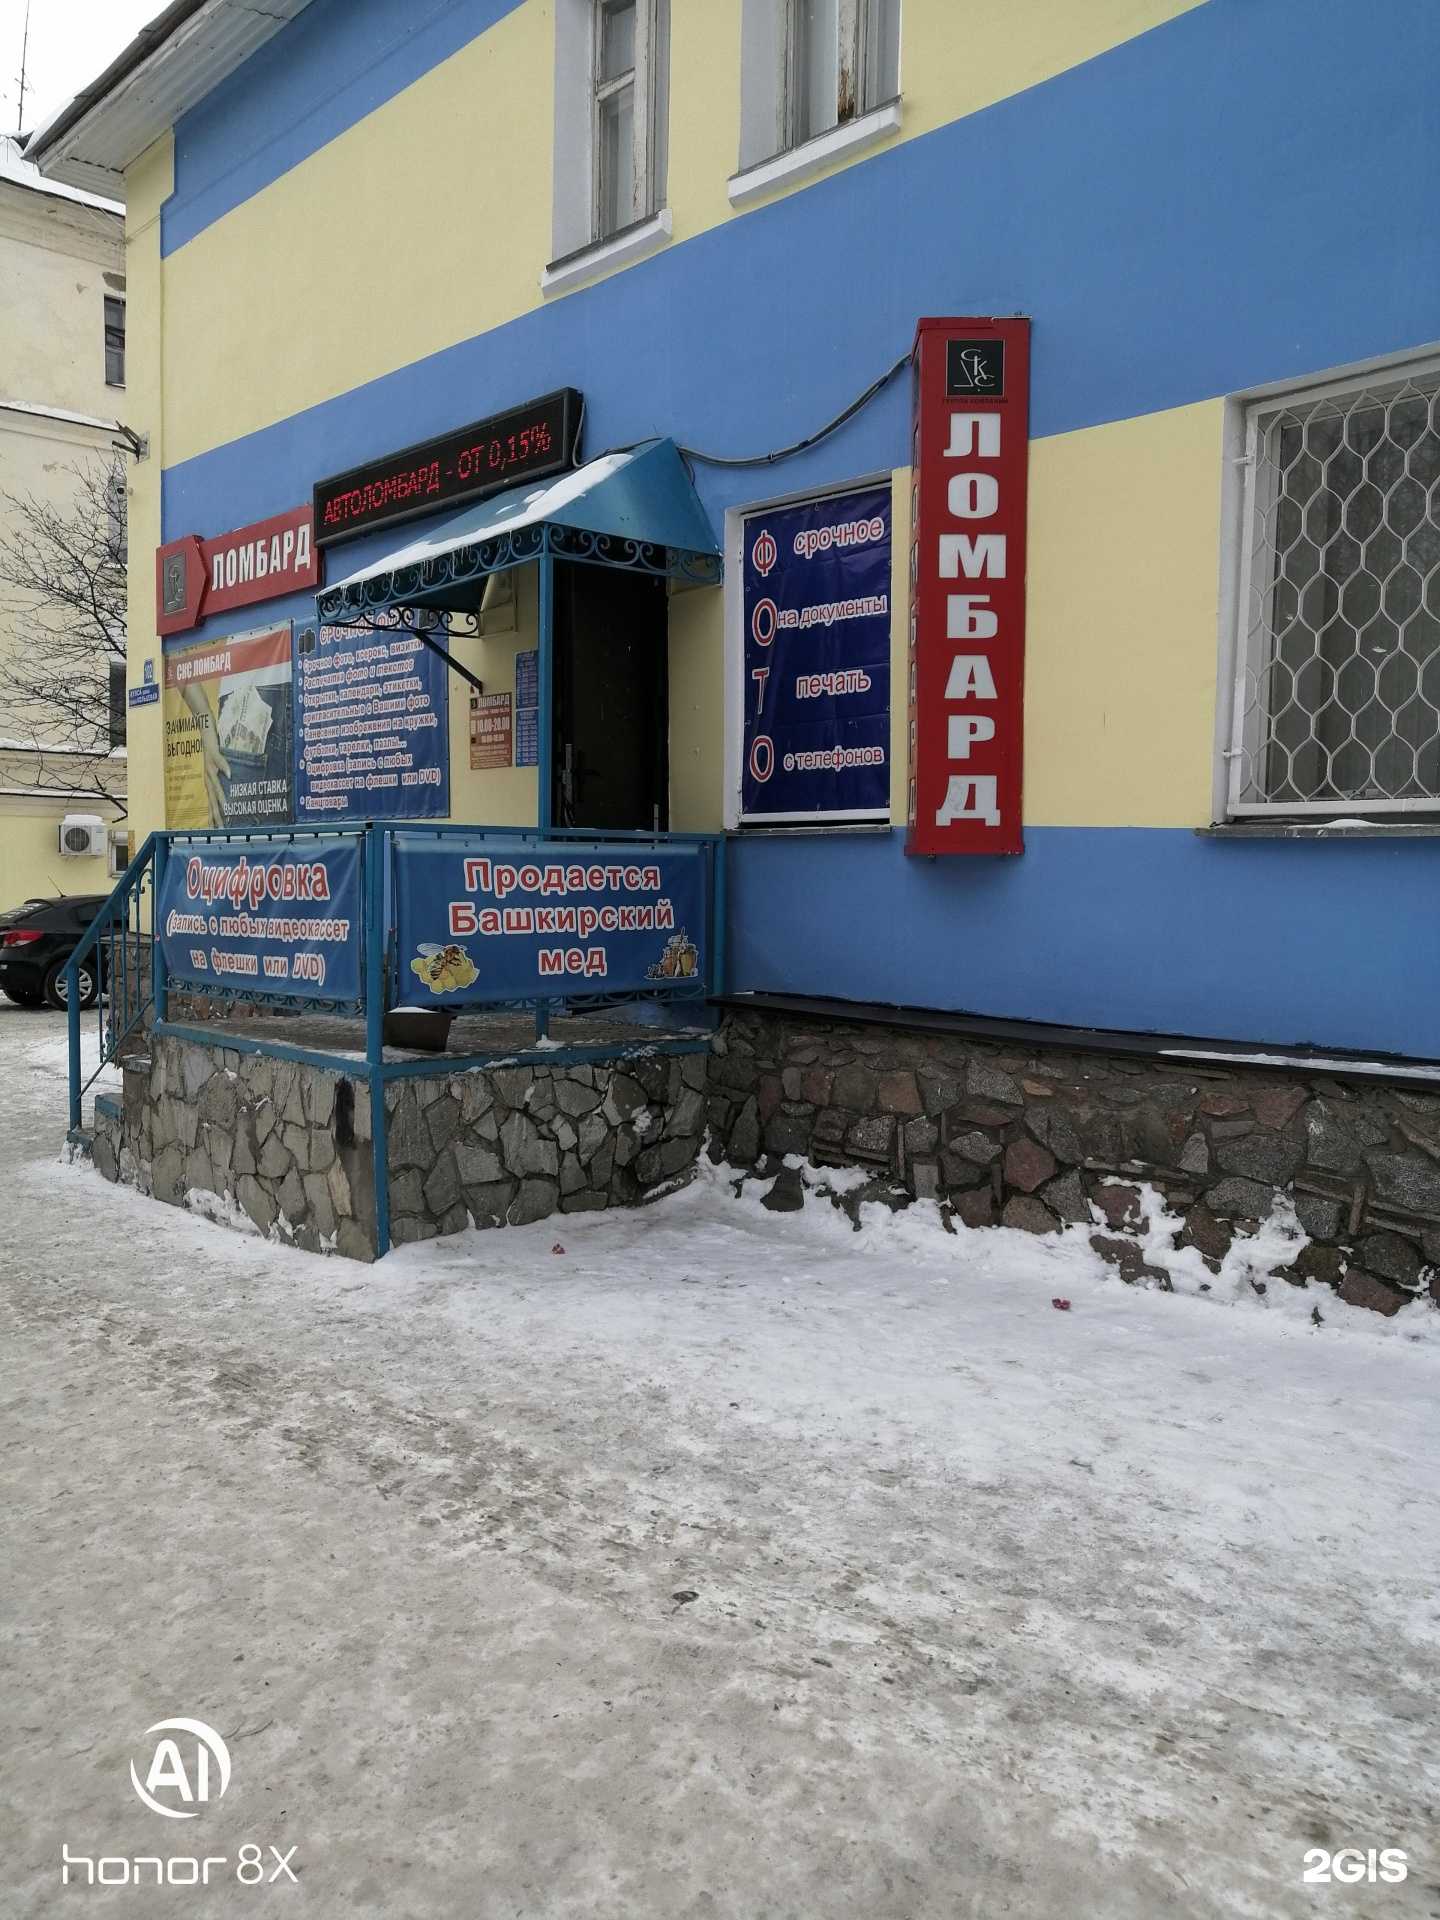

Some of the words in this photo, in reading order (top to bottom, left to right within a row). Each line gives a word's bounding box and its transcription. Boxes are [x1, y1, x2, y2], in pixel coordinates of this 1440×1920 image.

[323, 460, 440, 525] АВТОЛОМБАРД
[458, 444, 485, 481] ОТ
[488, 422, 552, 471] 0,15%
[794, 517, 884, 559] срочное
[211, 523, 311, 592] ЛОМБАРД
[777, 609, 799, 629] на
[800, 595, 887, 629] документы
[936, 411, 1007, 827] ЛОМБАРД
[193, 651, 232, 678] ЛОМБАРД
[796, 669, 872, 699] печать
[406, 694, 430, 711] фото
[166, 712, 209, 735] ЗАНИМАЙТЕ
[783, 753, 794, 771] с
[795, 745, 885, 772] телефонов
[230, 782, 257, 798] НИЗКАЯ
[258, 779, 288, 795] СТАВКА
[418, 768, 441, 786] DVD)
[223, 800, 257, 816] ВЫСОКАЯ
[257, 798, 288, 816] ОЦЕНКА
[187, 856, 331, 910] Оцифровка
[464, 858, 661, 898] Продается
[167, 909, 207, 937] (запись
[208, 916, 218, 936] с
[219, 912, 267, 938] любых
[267, 917, 350, 943] видеокассет
[449, 898, 675, 938] Башкирский
[190, 949, 208, 969] на
[211, 947, 259, 975] флешки
[263, 956, 288, 978] или
[292, 952, 326, 986] DVD)
[538, 946, 607, 977] мед
